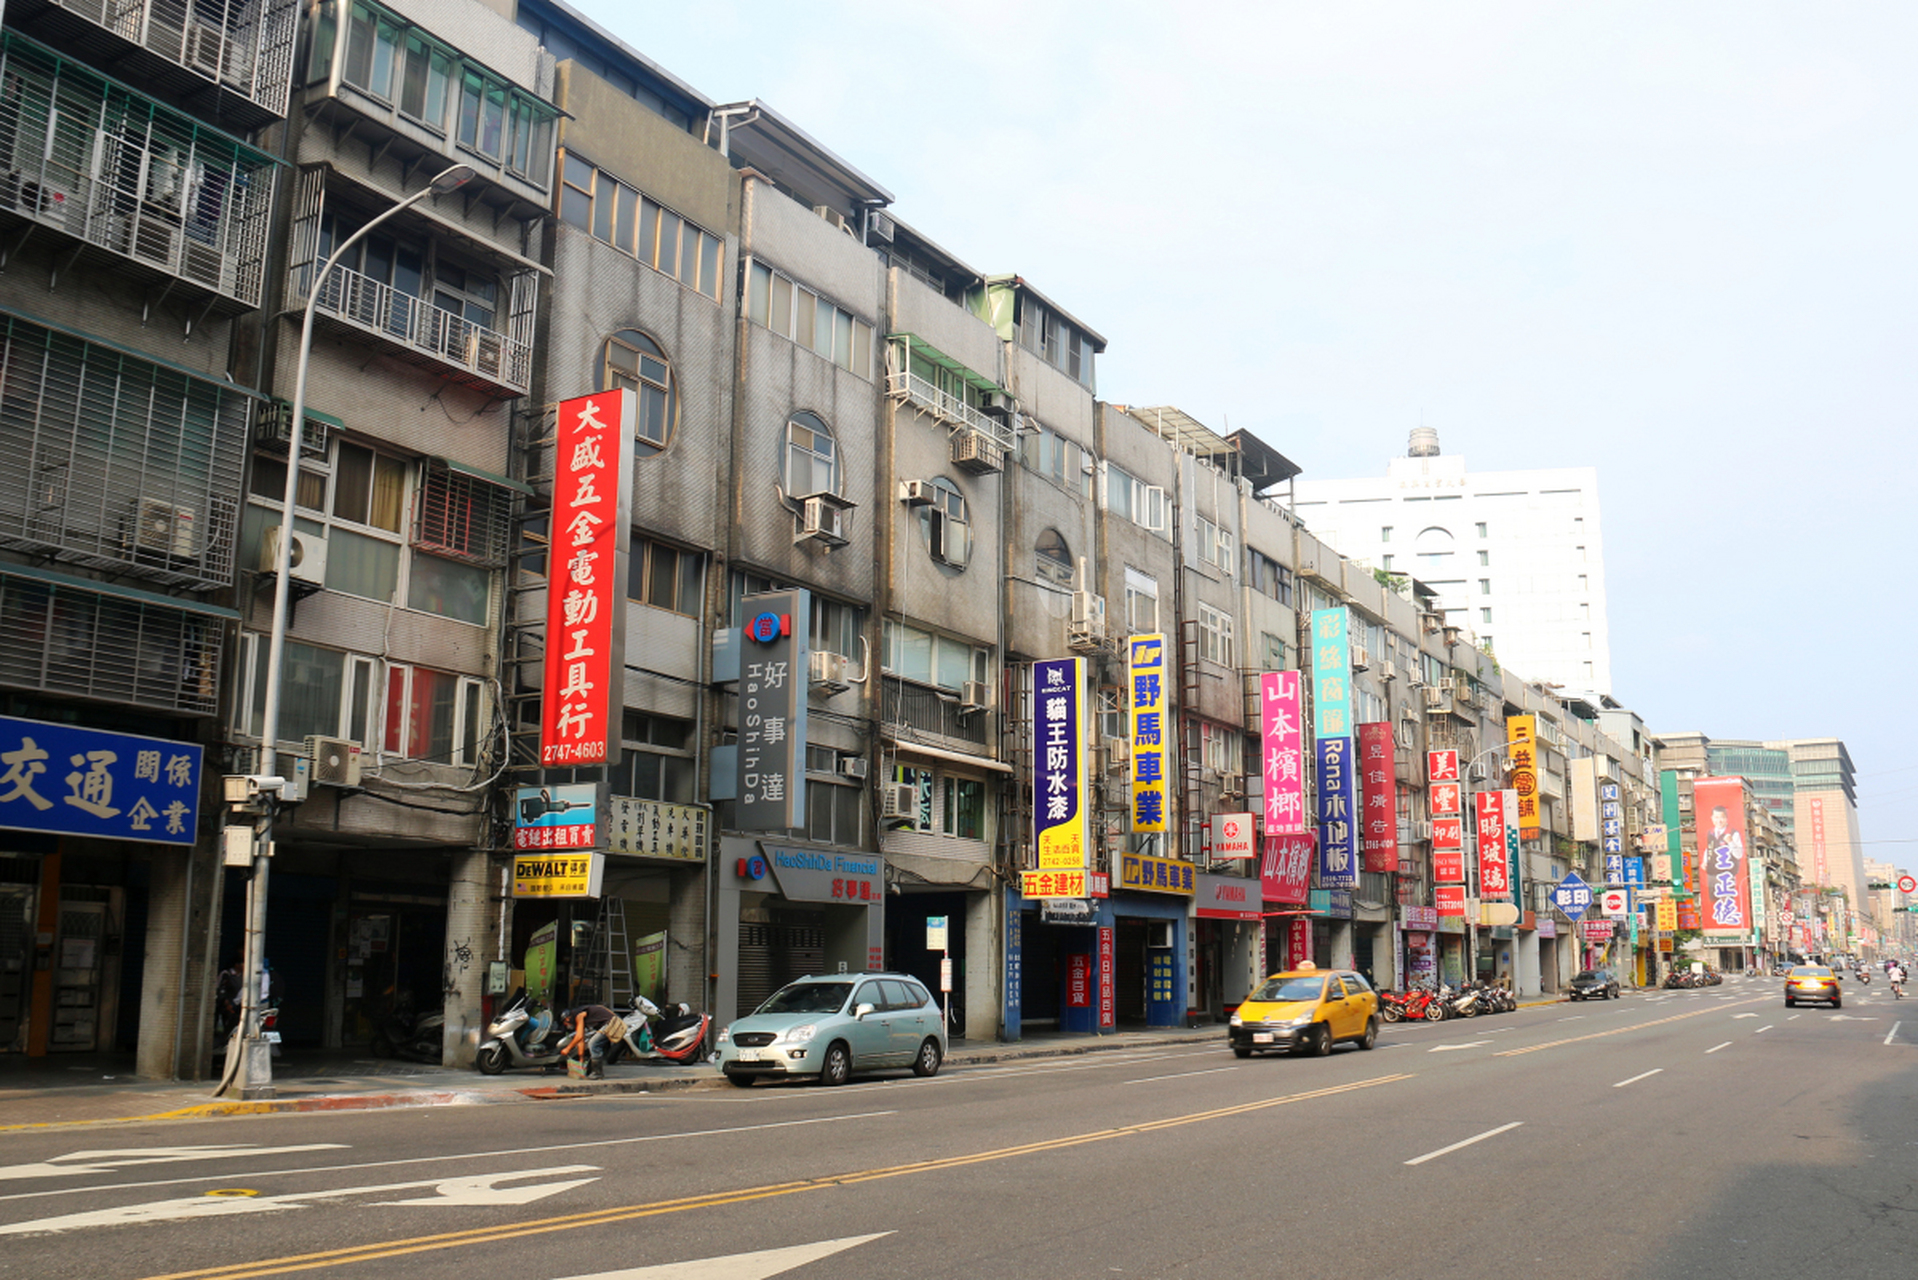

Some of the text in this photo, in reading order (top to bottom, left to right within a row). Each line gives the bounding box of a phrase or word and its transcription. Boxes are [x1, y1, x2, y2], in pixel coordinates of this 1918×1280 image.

[556, 400, 606, 739] 大盛五金電動工具行
[543, 742, 605, 761] 2747-4603
[743, 663, 762, 804] HaoShihDa
[761, 660, 788, 802] 好事達
[1134, 673, 1163, 826] 野馬車業
[1266, 673, 1300, 822] 山本檳榔
[0, 737, 121, 820] 交通
[1046, 696, 1069, 820] 貓王防水漆
[127, 796, 191, 835] 企業
[1325, 795, 1349, 872] 木地板
[1434, 824, 1460, 841] 印刷
[775, 851, 877, 875] HaoShihDa Financial
[1215, 841, 1249, 853] YAMAHA
[832, 878, 871, 900] 好事達
[1024, 873, 1084, 896] 五金建材
[1142, 859, 1194, 891] 野馬車業
[1556, 889, 1589, 905] 影印
[1712, 845, 1743, 925] 王正德
[1072, 956, 1085, 1004] 五金百貨
